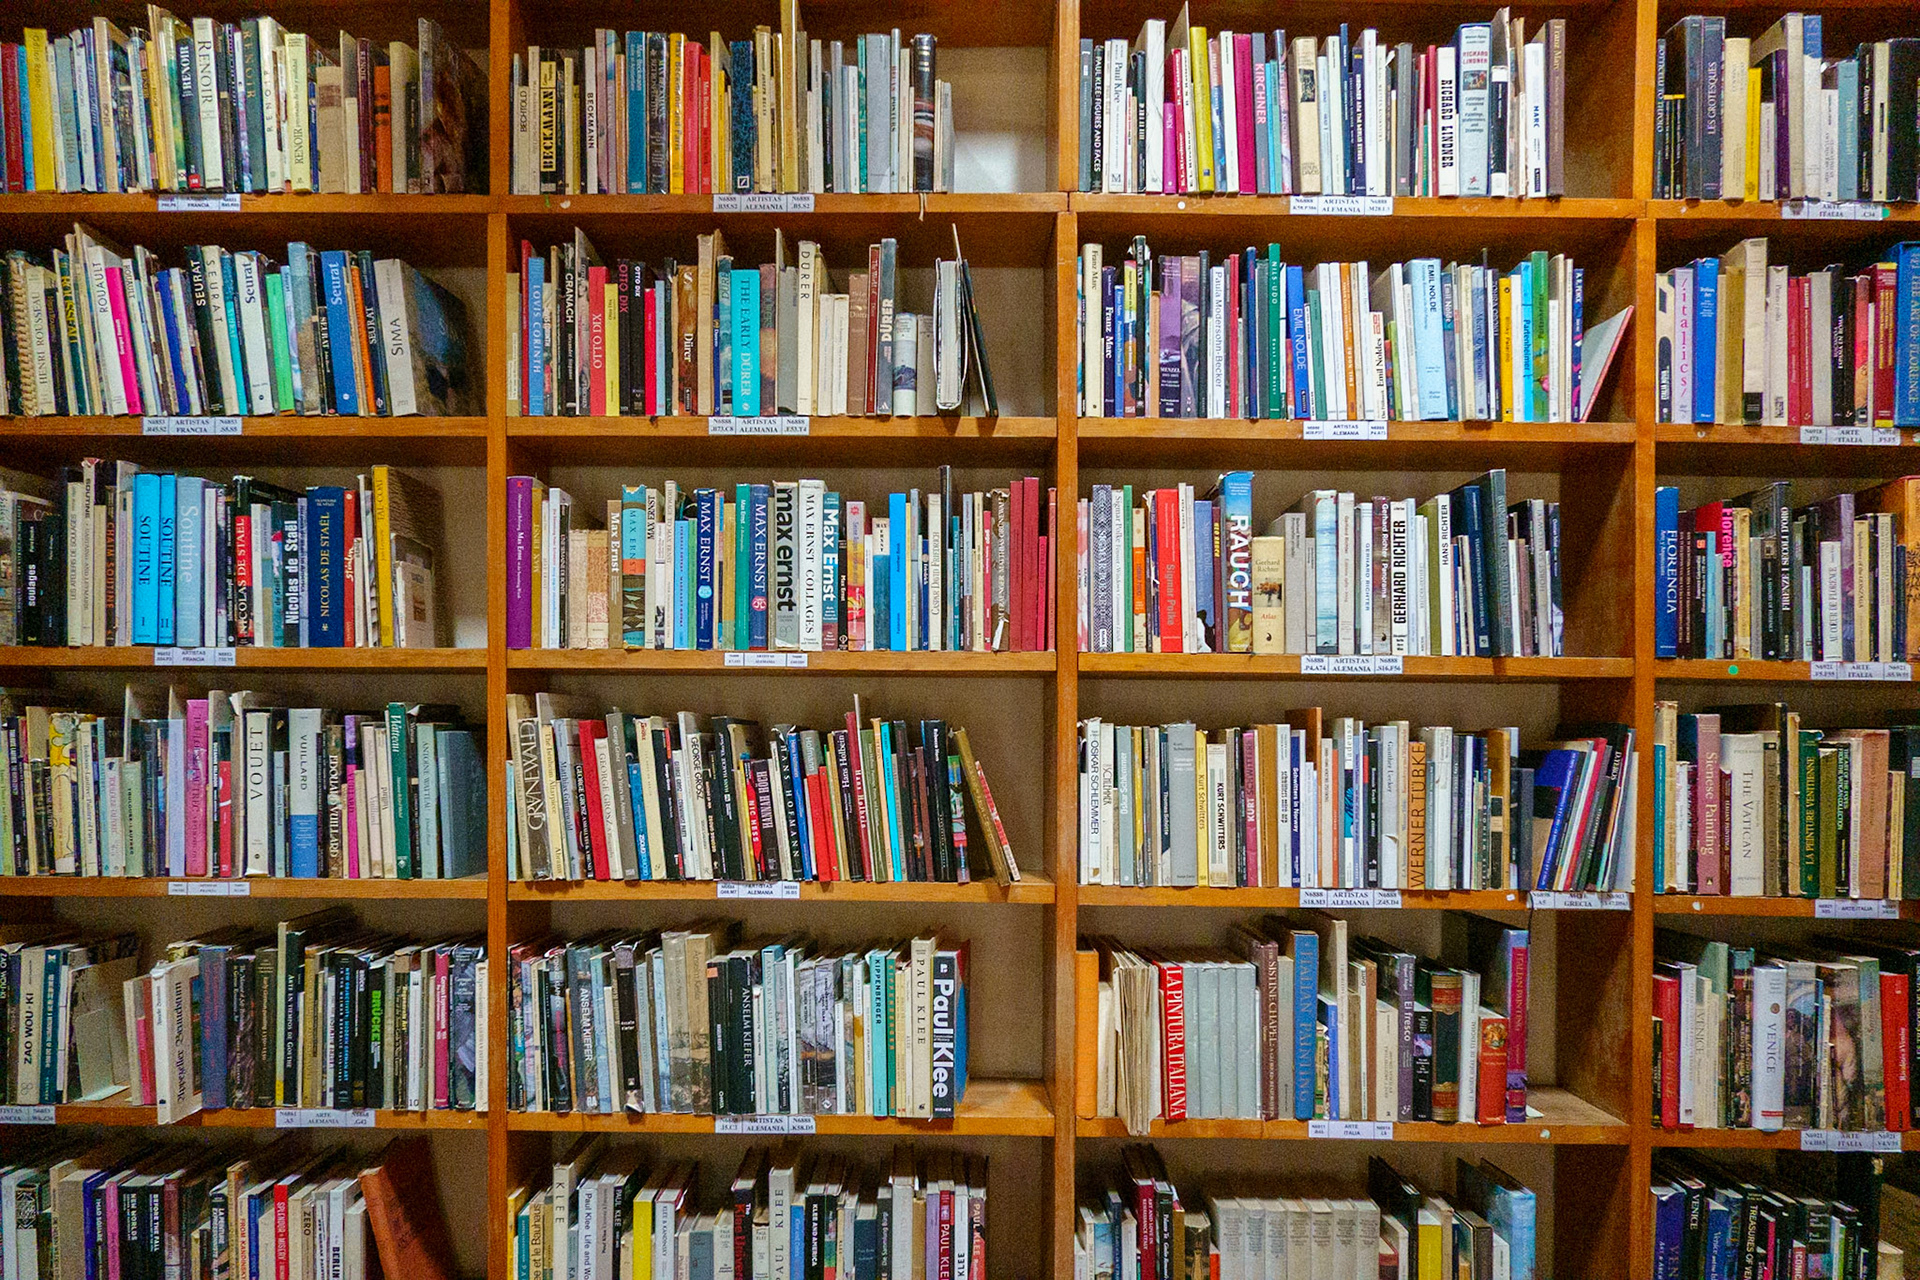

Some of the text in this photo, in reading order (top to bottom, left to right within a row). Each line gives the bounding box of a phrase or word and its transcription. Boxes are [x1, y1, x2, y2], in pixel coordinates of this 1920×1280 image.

[181, 46, 192, 91] RENOIR
[198, 40, 213, 105] RENOIR
[243, 31, 255, 98] RENOIR
[1113, 62, 1122, 103] Paul Klee
[1255, 63, 1265, 124] KIRCHNER
[264, 70, 273, 133] RENOIR
[543, 90, 553, 169] BECKMANN
[1441, 79, 1454, 168] RICHARD LINDNER
[1707, 62, 1718, 135] LES GROTESQUES
[294, 129, 304, 164] RENOIR
[92, 262, 108, 313] ROUAULT
[192, 260, 206, 306] SEURAT
[206, 261, 223, 324] SEURAT
[242, 263, 256, 305] Seurat
[330, 263, 343, 306] Seurat
[565, 272, 574, 323] CRANACH
[619, 264, 628, 313] OTTO DIX
[31, 292, 48, 384] HENRI ROUSSEAU
[366, 307, 377, 344] SEURAT
[390, 318, 404, 357] SIMA
[593, 312, 602, 369] OTTO DIX
[683, 332, 694, 363] Dürer
[740, 277, 751, 396] THE EARLY DÜRER
[881, 299, 894, 341] DÜRER
[1105, 306, 1114, 359] Franz Marc
[1294, 308, 1307, 370] EMIL NOLDE
[1909, 323, 1917, 338] OF
[1908, 339, 1917, 403] FLORENCE
[139, 515, 151, 586] SOUTINE
[161, 518, 173, 587] SOUTINE
[180, 505, 198, 584] Soutine
[321, 511, 330, 617] NICOLAS DE STAËL
[609, 512, 619, 573] Max Ernst
[700, 501, 710, 582] MAX ERNST
[754, 503, 765, 591] MAX ERNST
[776, 487, 793, 612] max ernst
[805, 493, 814, 634] MAX ERNST COLLAGES
[822, 508, 838, 601] Max Ernst
[1230, 514, 1250, 608] RAUCH
[1722, 507, 1732, 567] Florence
[285, 519, 299, 624] Nicolas de Staël
[1165, 563, 1174, 626] Sigmar Polke
[1393, 520, 1406, 624] GERHARD RICHTER
[1667, 530, 1677, 613] FLORENCIA
[250, 727, 263, 800] VOUET
[392, 714, 402, 753] Watteau
[691, 736, 704, 800] GEORGE GROSZ
[756, 770, 774, 829] HANNAH HÖCH
[1091, 740, 1099, 834] OSKAR SCHLEMMER
[784, 744, 803, 858] HANS HOFMANN
[1411, 743, 1426, 888] WERNER TÜBKE
[1701, 752, 1718, 855] Sienese Painting
[24, 992, 34, 1065] ZAO WOU-KI
[371, 990, 381, 1042] BRÜCKE
[580, 988, 592, 1061] ANSELM KIEFER
[742, 987, 753, 1067] ANSELM KIEFER
[917, 959, 926, 1045] PAUL KLEE
[1300, 951, 1313, 1102] ITALIAN PAINTING
[933, 979, 954, 1098] Paul Klee
[1167, 969, 1185, 1117] LA PINTURA ITALIANA
[1766, 1023, 1776, 1074] VENICE
[303, 1210, 311, 1236] ZERO
[555, 1182, 564, 1223] KLEE
[735, 1203, 744, 1233] Klee
[1690, 1194, 1700, 1230] VENICE
